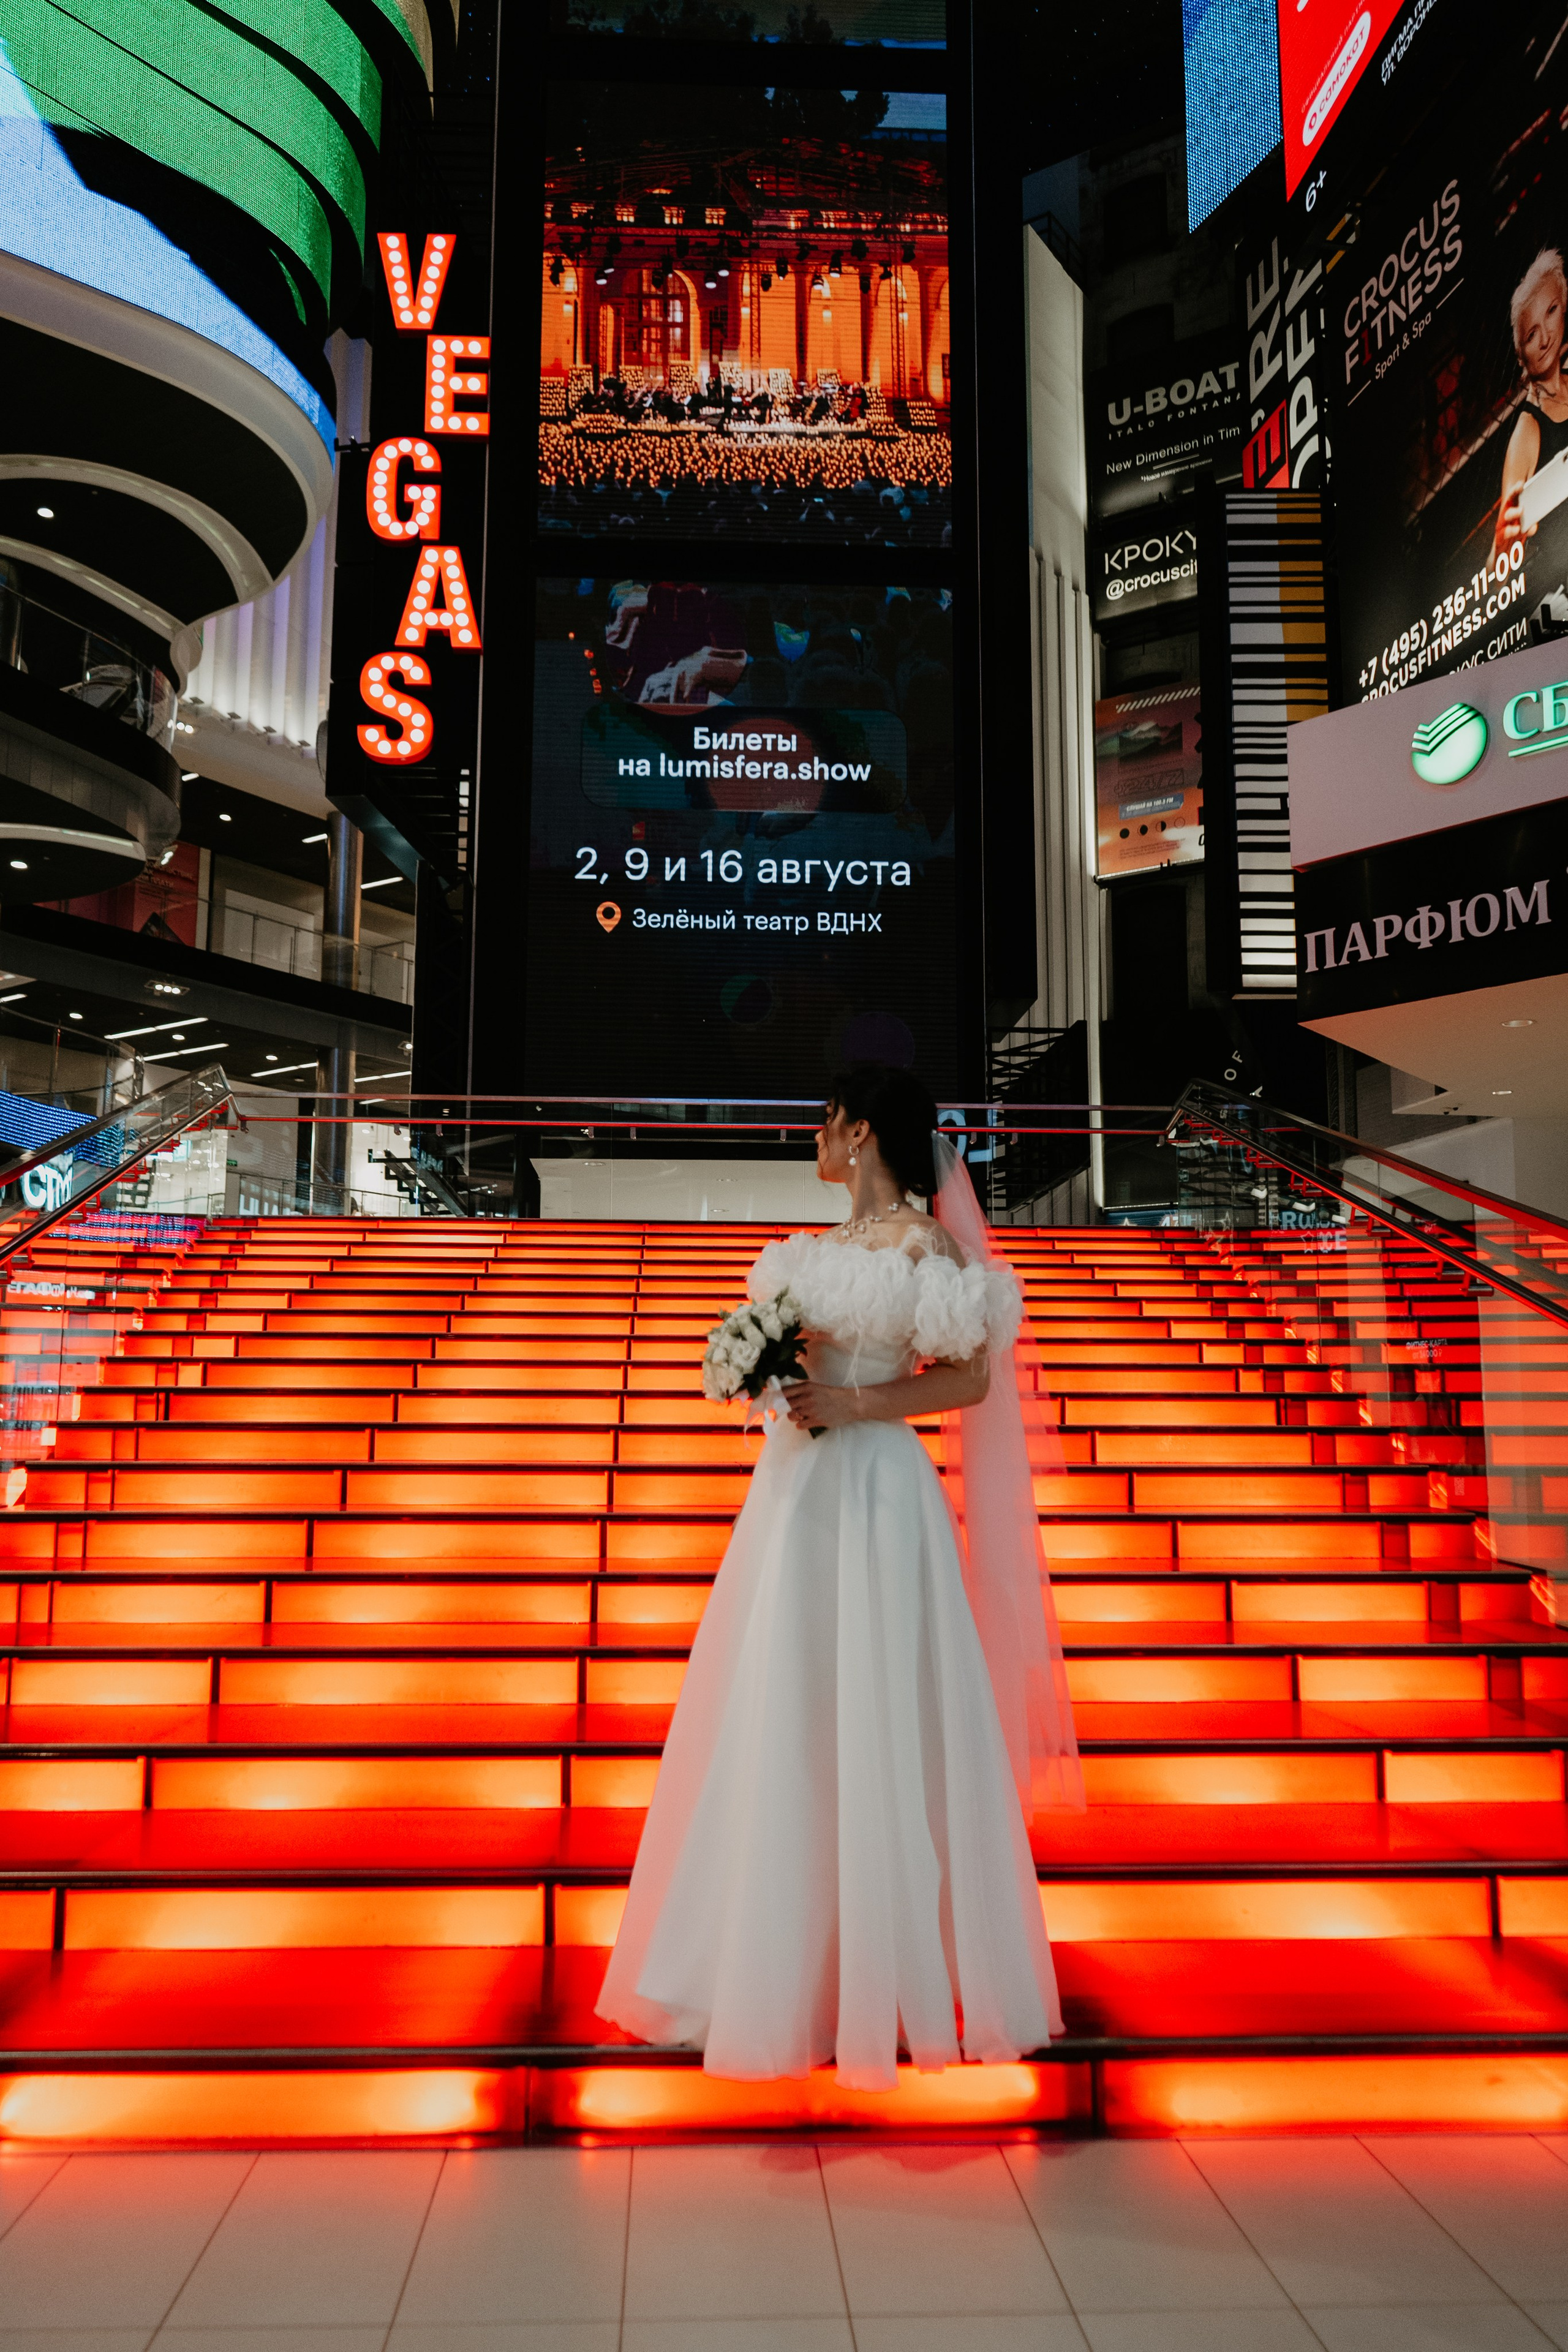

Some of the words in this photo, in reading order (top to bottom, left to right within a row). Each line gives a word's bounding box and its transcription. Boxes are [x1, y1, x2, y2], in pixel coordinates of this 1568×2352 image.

[1381, 17, 1413, 77] ДИГМА
[1306, 170, 1327, 213] 6+
[1344, 179, 1460, 338] CROCUS
[1375, 343, 1400, 380] Sport
[1402, 333, 1410, 350] &
[1412, 311, 1432, 339] Spa
[1108, 362, 1239, 426] U-BOAT
[1109, 420, 1155, 440] ITALO
[1106, 459, 1133, 475] New
[1136, 439, 1199, 466] Dimension
[1203, 434, 1214, 446] in
[357, 233, 491, 764] VEGAS
[1359, 656, 1378, 688] +7
[1382, 619, 1428, 676] (495)
[1432, 541, 1524, 635] 236-11-00
[1487, 617, 1528, 660] СИТИ
[693, 727, 797, 752] Билеты
[618, 758, 650, 777] на
[660, 753, 871, 782] lumisfera.show
[574, 847, 609, 884] 2,
[625, 848, 649, 881] 9
[665, 856, 686, 882] и
[700, 850, 743, 883] 16
[757, 858, 911, 892] августа
[632, 908, 736, 929] Зелёный
[743, 914, 809, 935] театр
[817, 913, 882, 935] ВДНХ
[1304, 880, 1552, 973] ПАРФЮМ
